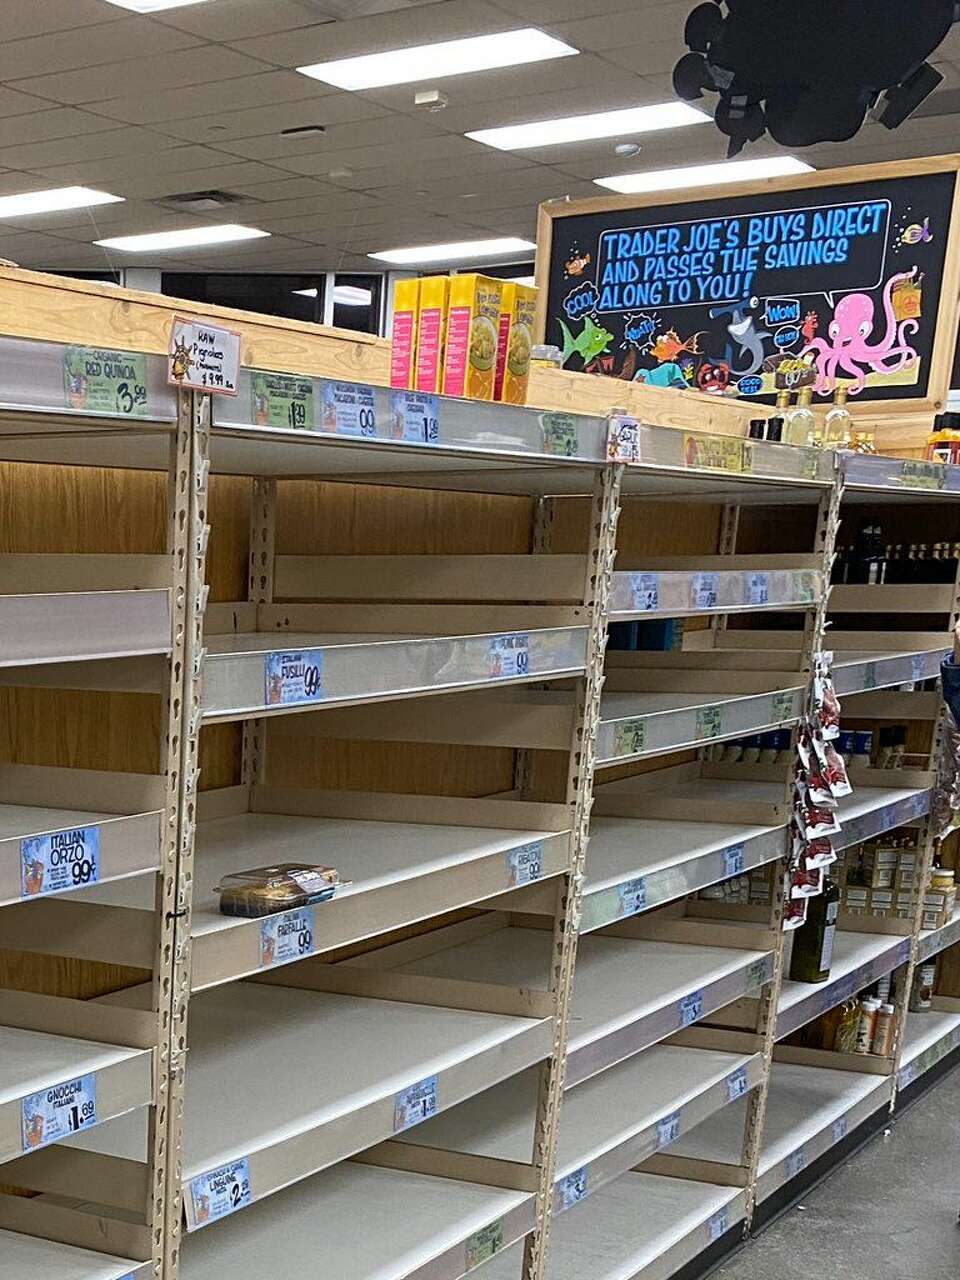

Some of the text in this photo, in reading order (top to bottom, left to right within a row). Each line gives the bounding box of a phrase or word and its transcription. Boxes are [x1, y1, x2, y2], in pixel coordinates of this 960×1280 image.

[603, 203, 888, 260] TRADER JOE'S BUYS DIRECT
[602, 238, 848, 285] AND PASSES THE SAVINGS
[600, 270, 753, 309] ALONG TO YOU!
[567, 290, 595, 315] COOL
[85, 362, 137, 380] RED QUINOA
[50, 830, 86, 850] ITALIAN
[50, 844, 85, 866] ORZO
[47, 1080, 82, 1103] GNOCCHI
[68, 1100, 95, 1132] $1.69
